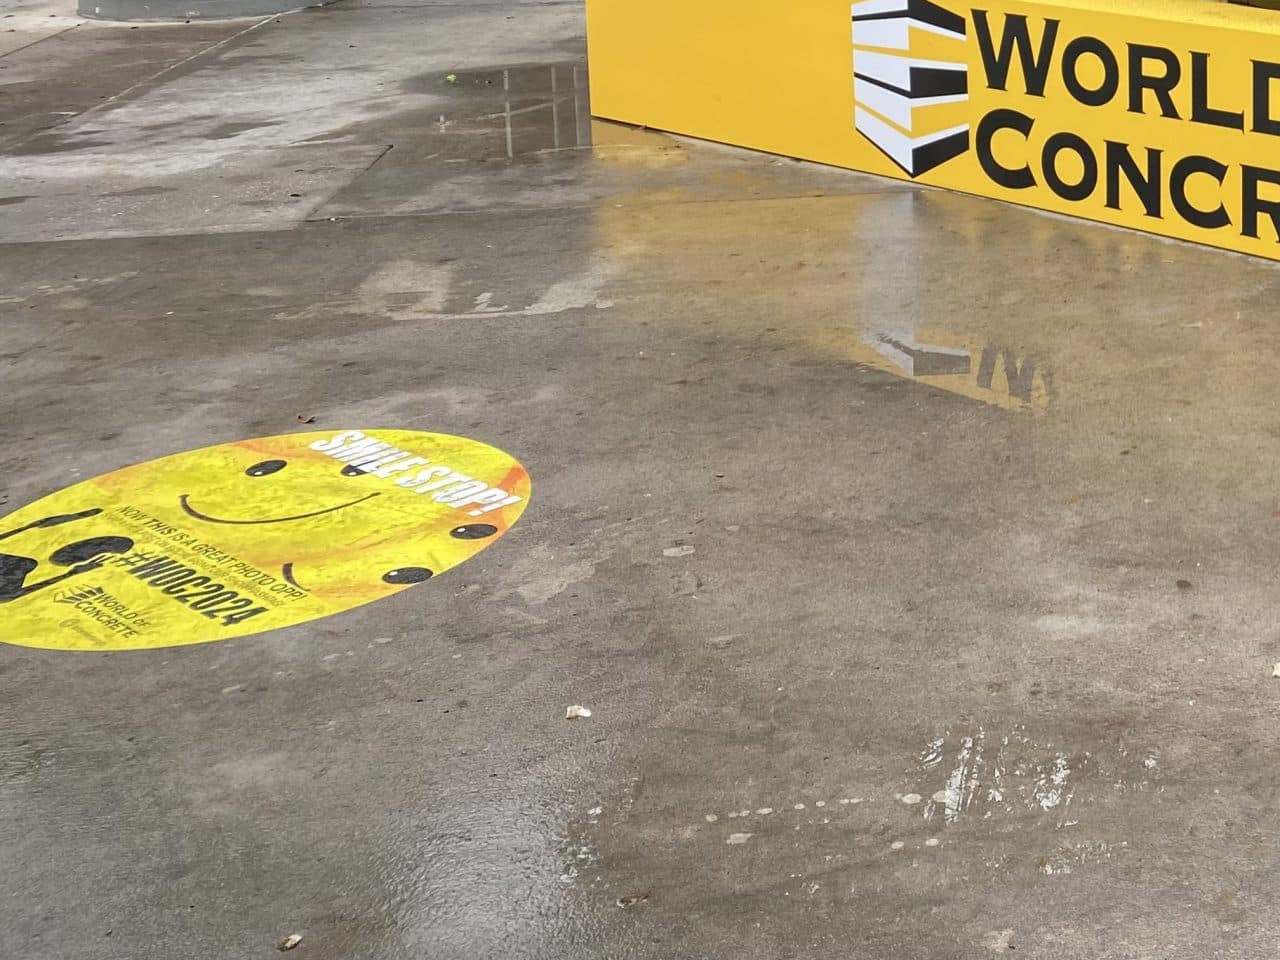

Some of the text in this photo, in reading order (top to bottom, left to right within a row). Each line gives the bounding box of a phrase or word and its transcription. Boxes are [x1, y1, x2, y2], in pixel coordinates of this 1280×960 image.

[309, 429, 523, 516] SMILE STOP!
[110, 551, 270, 626] #WOC2024
[115, 506, 149, 520] NOW
[143, 518, 177, 535] THIS
[168, 532, 190, 541] IS
[191, 543, 238, 566] GREAT
[228, 562, 277, 586] PHOTO
[270, 583, 308, 602] OPP!
[75, 601, 140, 638] CONCRETE
[94, 593, 139, 620] WORLD
